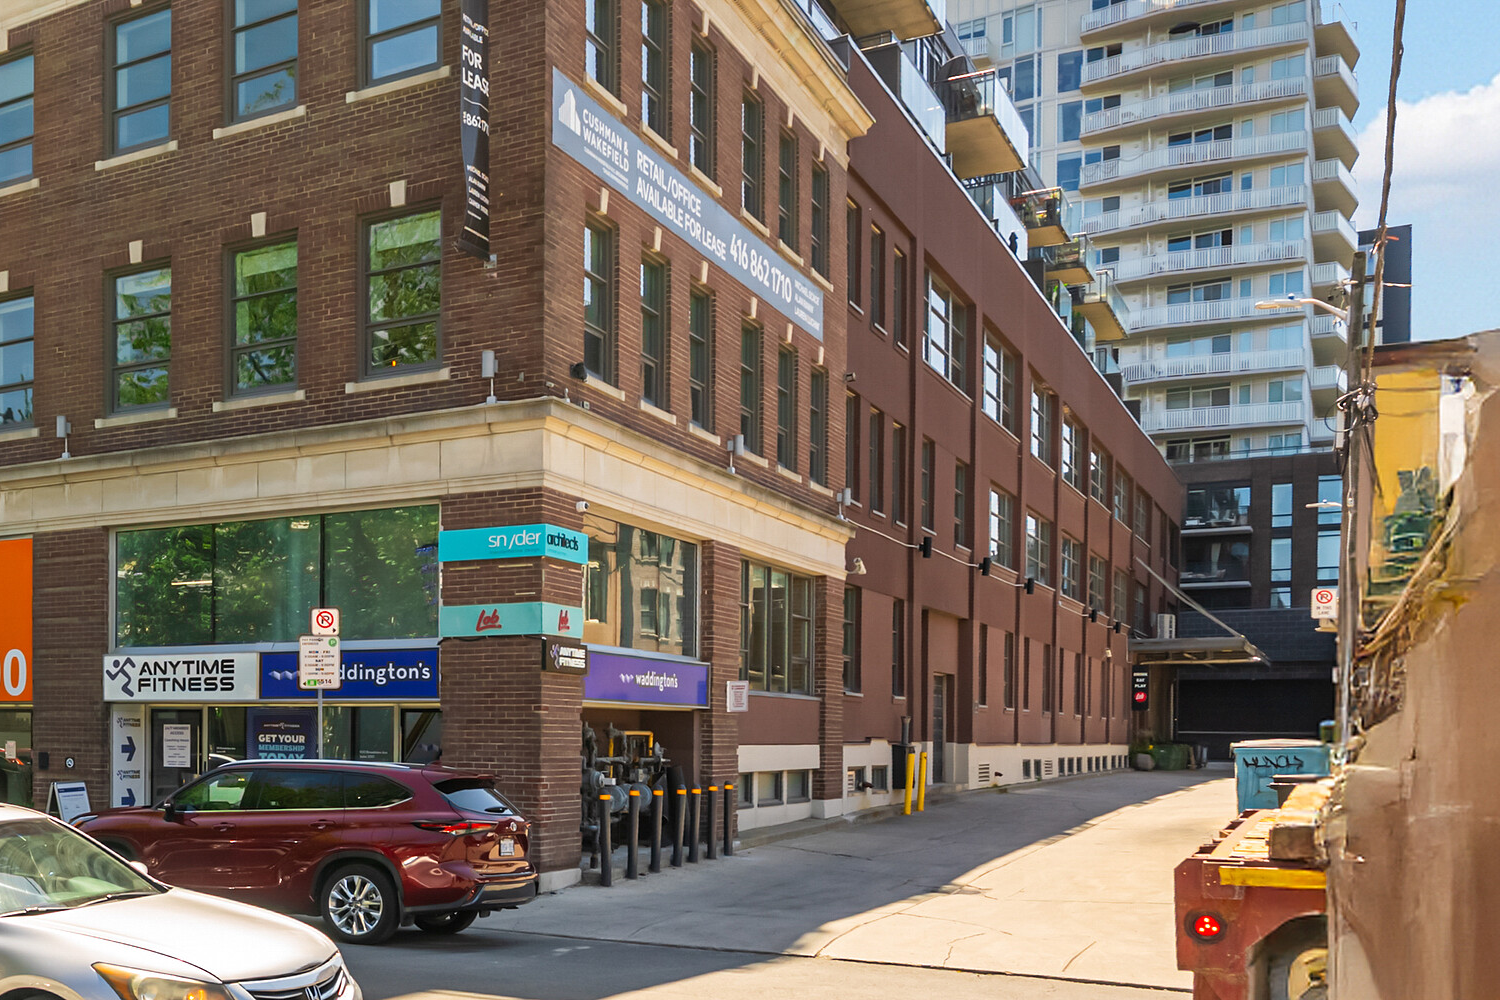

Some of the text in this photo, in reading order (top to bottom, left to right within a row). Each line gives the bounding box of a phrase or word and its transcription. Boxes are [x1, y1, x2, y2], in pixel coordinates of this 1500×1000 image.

[462, 44, 483, 70] FOR
[582, 108, 629, 156] CUSHMAN &
[582, 125, 629, 172] WAKEFIELD
[636, 176, 684, 229] AVAILABLE
[684, 212, 701, 242] FOR
[702, 226, 727, 262] LEASE
[730, 233, 748, 270] 416
[750, 248, 770, 288] 862
[771, 266, 792, 303] 1710
[488, 529, 579, 551] snyder architects
[475, 608, 502, 632] Lob
[138, 659, 235, 675] ANYTIME
[340, 662, 431, 685] ddington's
[137, 676, 235, 692] FITNESS
[635, 670, 679, 691] waddington's
[258, 734, 305, 744] GET YOUR
[258, 744, 305, 752] MEMBERSHIP
